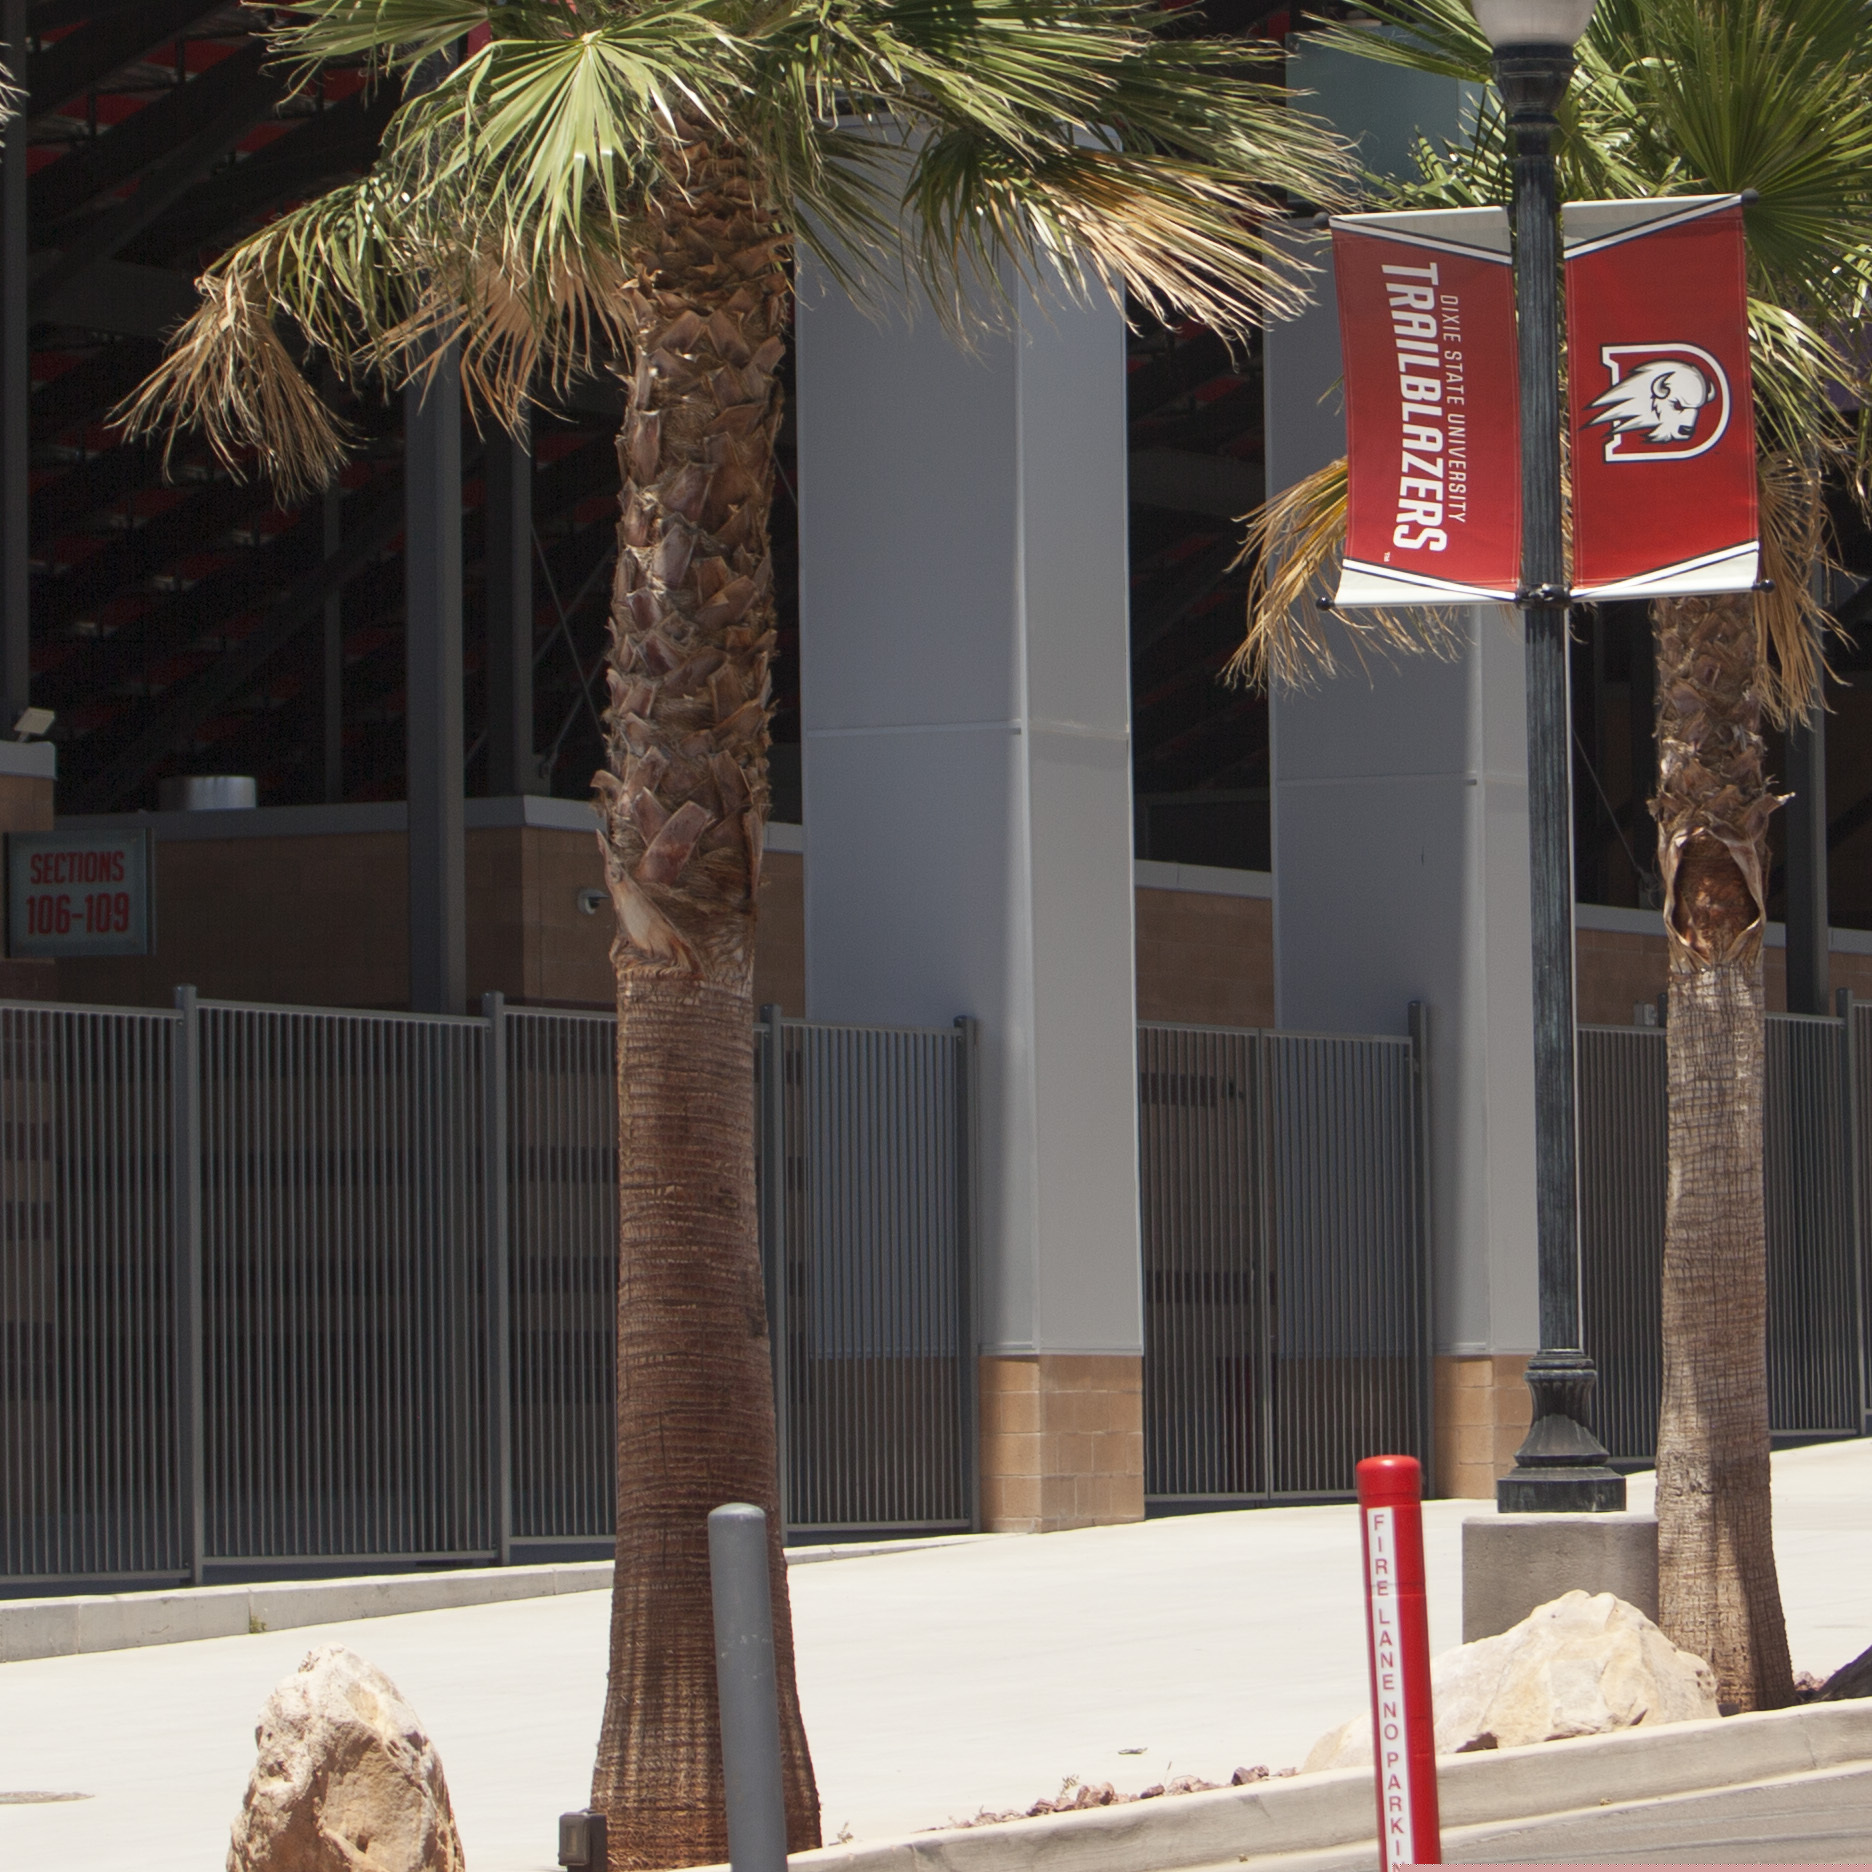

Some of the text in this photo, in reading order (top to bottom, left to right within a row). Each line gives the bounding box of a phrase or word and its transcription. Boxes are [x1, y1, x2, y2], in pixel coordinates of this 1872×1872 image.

[1381, 262, 1448, 552] TRAILBLAZERS
[1440, 295, 1467, 523] DIXIE STATE UNIVERSITY
[30, 851, 125, 885] SECTIONS
[25, 892, 130, 935] 106-109
[1373, 1514, 1389, 1597] FIRE
[1378, 1608, 1395, 1691] LANE
[1383, 1702, 1399, 1741] NO
